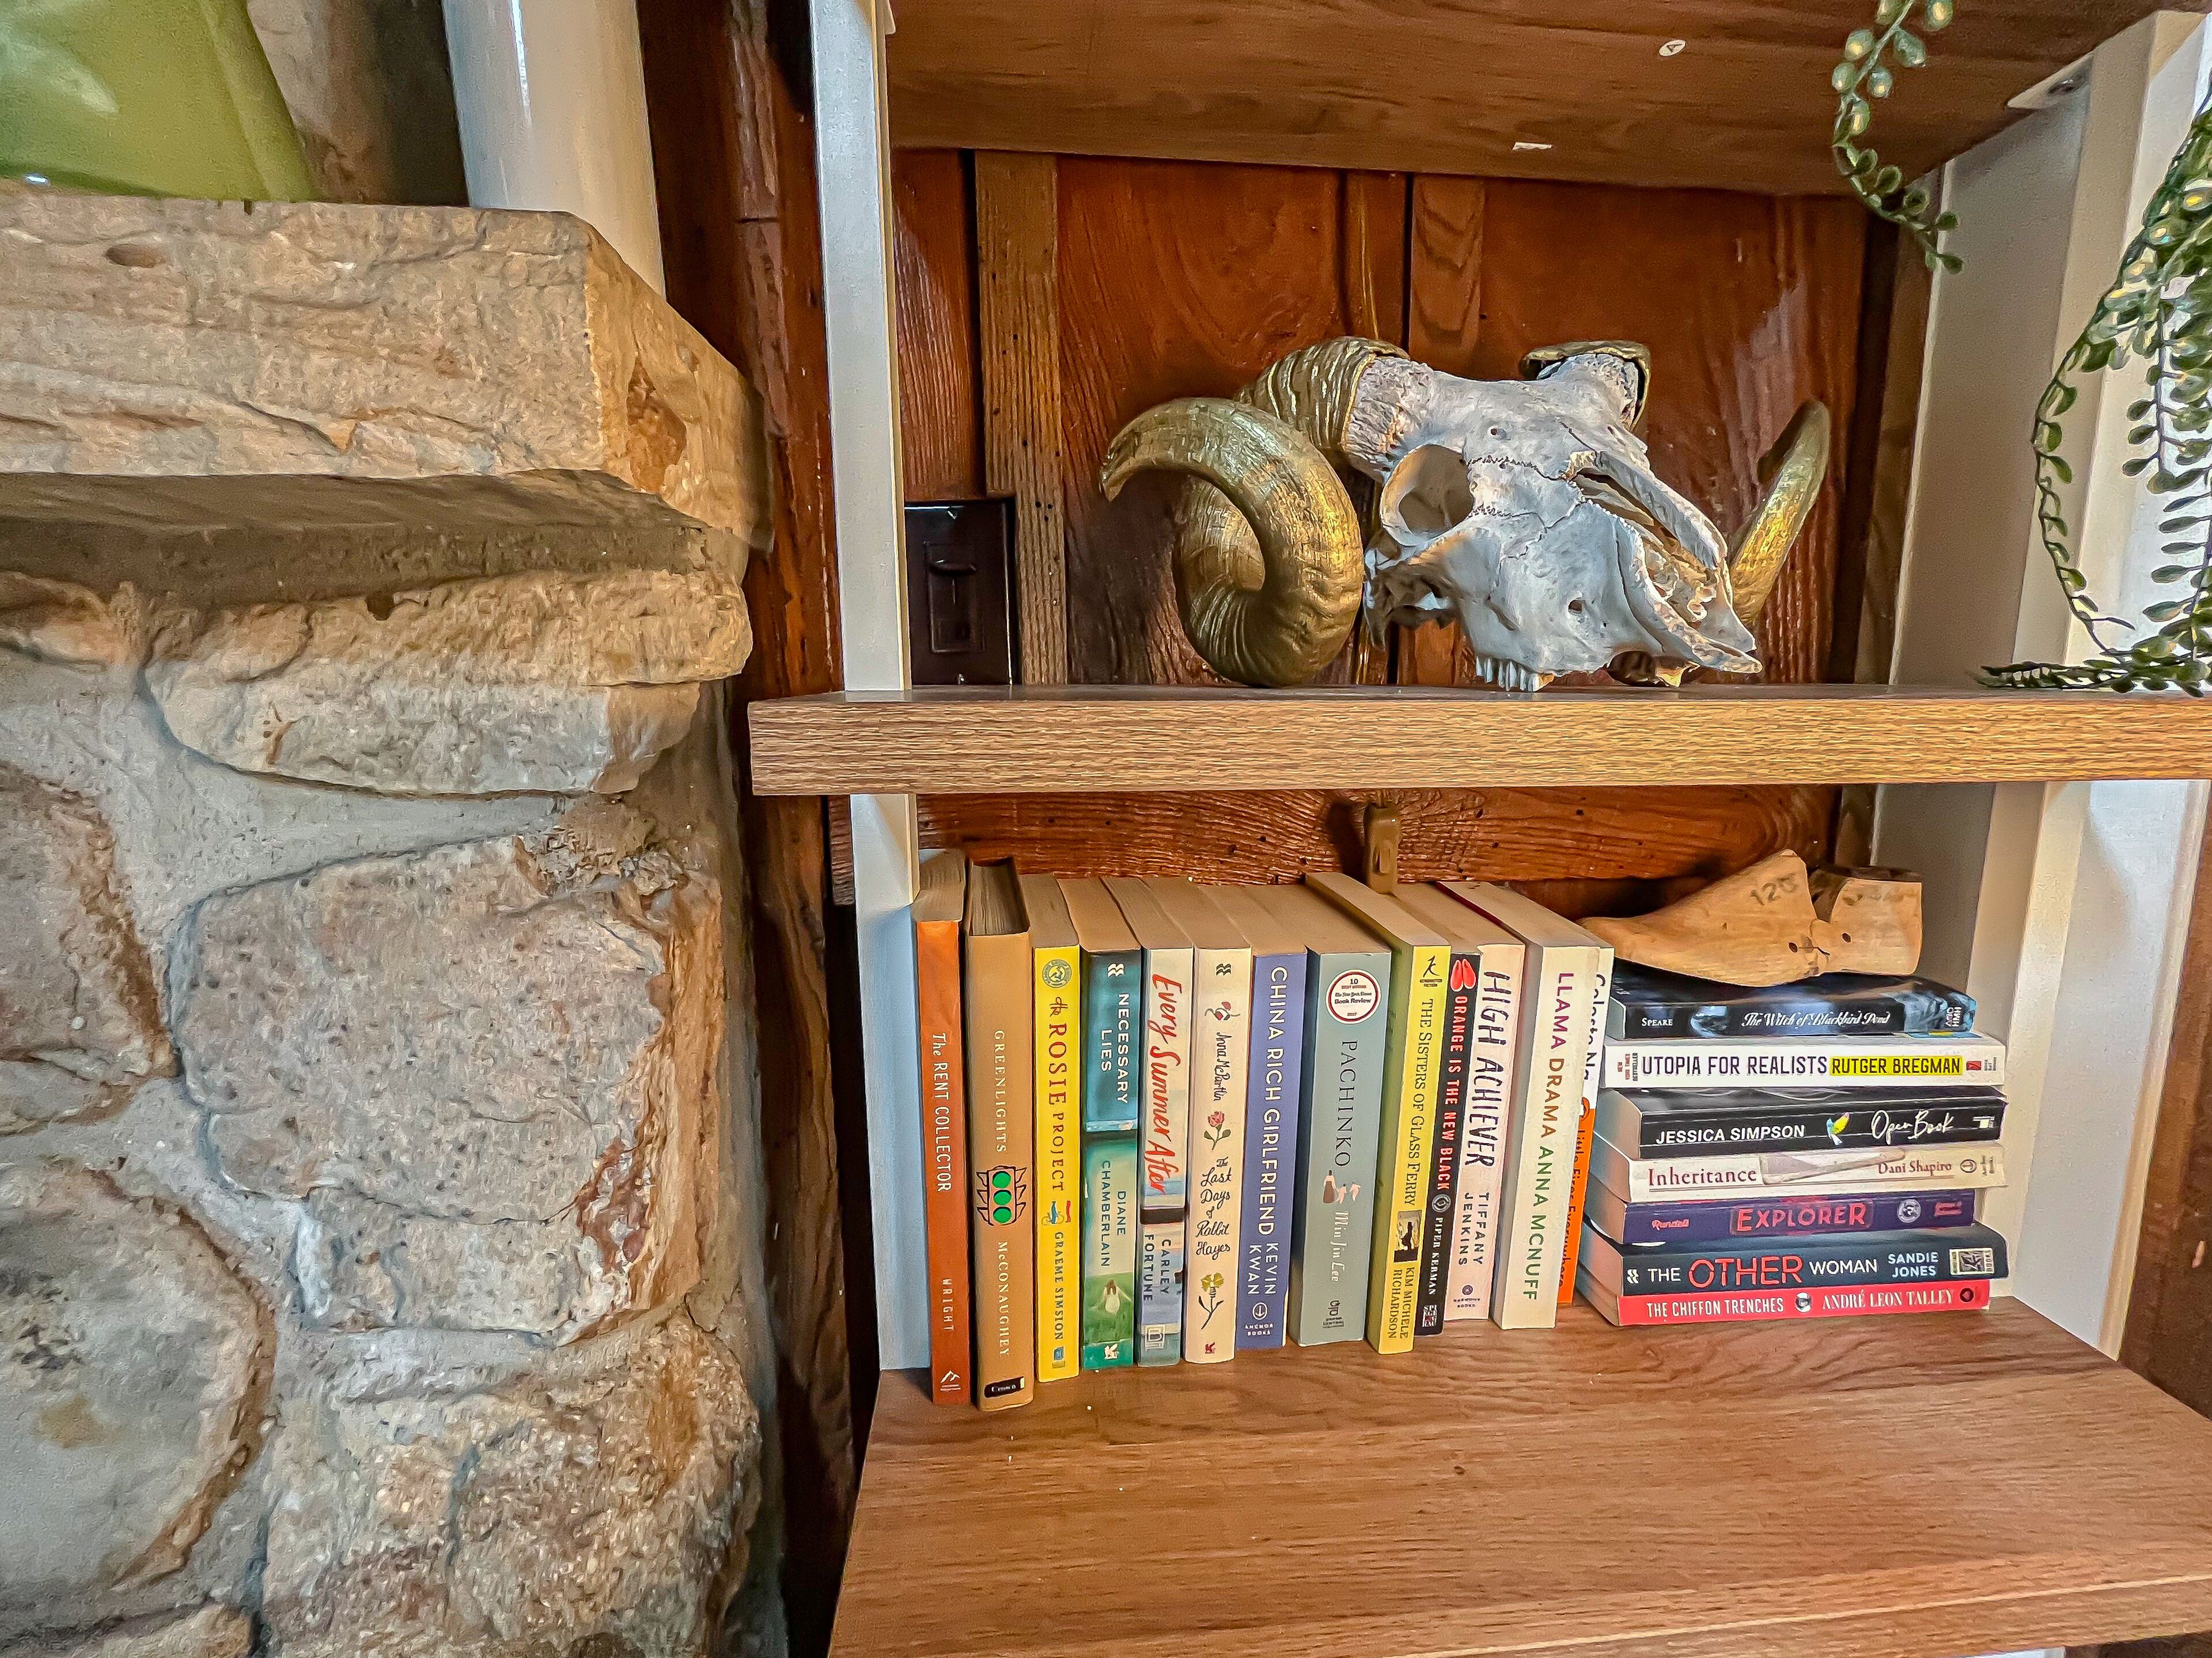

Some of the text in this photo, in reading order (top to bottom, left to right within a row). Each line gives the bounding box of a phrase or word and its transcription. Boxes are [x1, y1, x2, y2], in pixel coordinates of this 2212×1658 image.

[1420, 999, 1434, 1028] THE
[1741, 1012, 1763, 1027] The
[1764, 1012, 1794, 1026] Witch
[1048, 1022, 1067, 1105] ROSIE
[1101, 1029, 1113, 1072] LIES
[1117, 993, 1130, 1104] NECESSARY
[1216, 1032, 1232, 1058] Anna
[1414, 1034, 1432, 1090] SISTERS
[1642, 1056, 1700, 1075] UTOPIA
[1708, 1056, 1740, 1075] FOR
[1747, 1056, 1827, 1075] REALISTS
[1832, 1057, 1887, 1074] RUTGER
[1893, 1057, 1960, 1074] BREGMAN
[994, 1030, 1007, 1152] GREENLIGHTS
[1143, 974, 1182, 1196] Every Summer After
[1464, 972, 1512, 1167] HIGH ACHIEVER
[932, 1033, 952, 1192] The RENT COLLECTOR
[1258, 966, 1288, 1236] CHINA RICH GIRLFRIEND
[1334, 1040, 1358, 1167] PACHINKO
[1412, 1094, 1425, 1112] OF
[1437, 995, 1469, 1190] ORANGE IS THE NEW BLACK
[1406, 1117, 1425, 1159] GLASS
[1522, 973, 1574, 1300] LLAMA DRAMA ANNA MCNUFF
[1656, 1124, 1805, 1145] JESSICA SIMPSON
[1871, 1110, 1955, 1145] Open Book
[1051, 1112, 1065, 1191] PROJECT
[1216, 1156, 1229, 1168] The
[1878, 1160, 1952, 1177] Dani Shapiro
[1200, 1167, 1232, 1187] Last
[1200, 1189, 1230, 1208] Days
[1404, 1162, 1421, 1206] FERRY
[1647, 1167, 1757, 1186] Inheritance
[1101, 1160, 1111, 1267] CHAMBERLAIN
[1117, 1190, 1126, 1236] DIANE
[1195, 1221, 1230, 1238] Rabbit
[1332, 1211, 1350, 1238] Min
[1458, 1193, 1474, 1266] JENKINS
[1472, 1192, 1490, 1265] TIFFANY
[1736, 1203, 1866, 1231] EXPLORER
[1143, 1234, 1155, 1302] FORTUNE
[1160, 1238, 1172, 1295] CARLEY
[1195, 1241, 1231, 1260] Hayes
[1247, 1244, 1263, 1295] KWAN
[1264, 1243, 1279, 1295] KEVIN
[1330, 1240, 1347, 1259] Jin
[1429, 1217, 1444, 1295] PIPER KERMAN
[1647, 1255, 1878, 1289] THE OTHER WOMAN
[1888, 1252, 1940, 1265] SANDIE
[1892, 1265, 1937, 1278] JONES
[1054, 1231, 1065, 1341] GRAEME SIMSION
[1330, 1262, 1345, 1283] Lee
[942, 1278, 955, 1331] WRIGHT
[998, 1241, 1010, 1358] McCONAUGHEY
[1387, 1270, 1403, 1339] RICHARDSON
[1400, 1267, 1415, 1339] KIM MICHELE
[1647, 1297, 1784, 1318] THE CHIFFON TRENCHES
[1821, 1288, 1955, 1311] ANDRÉ LEON TALLEY
